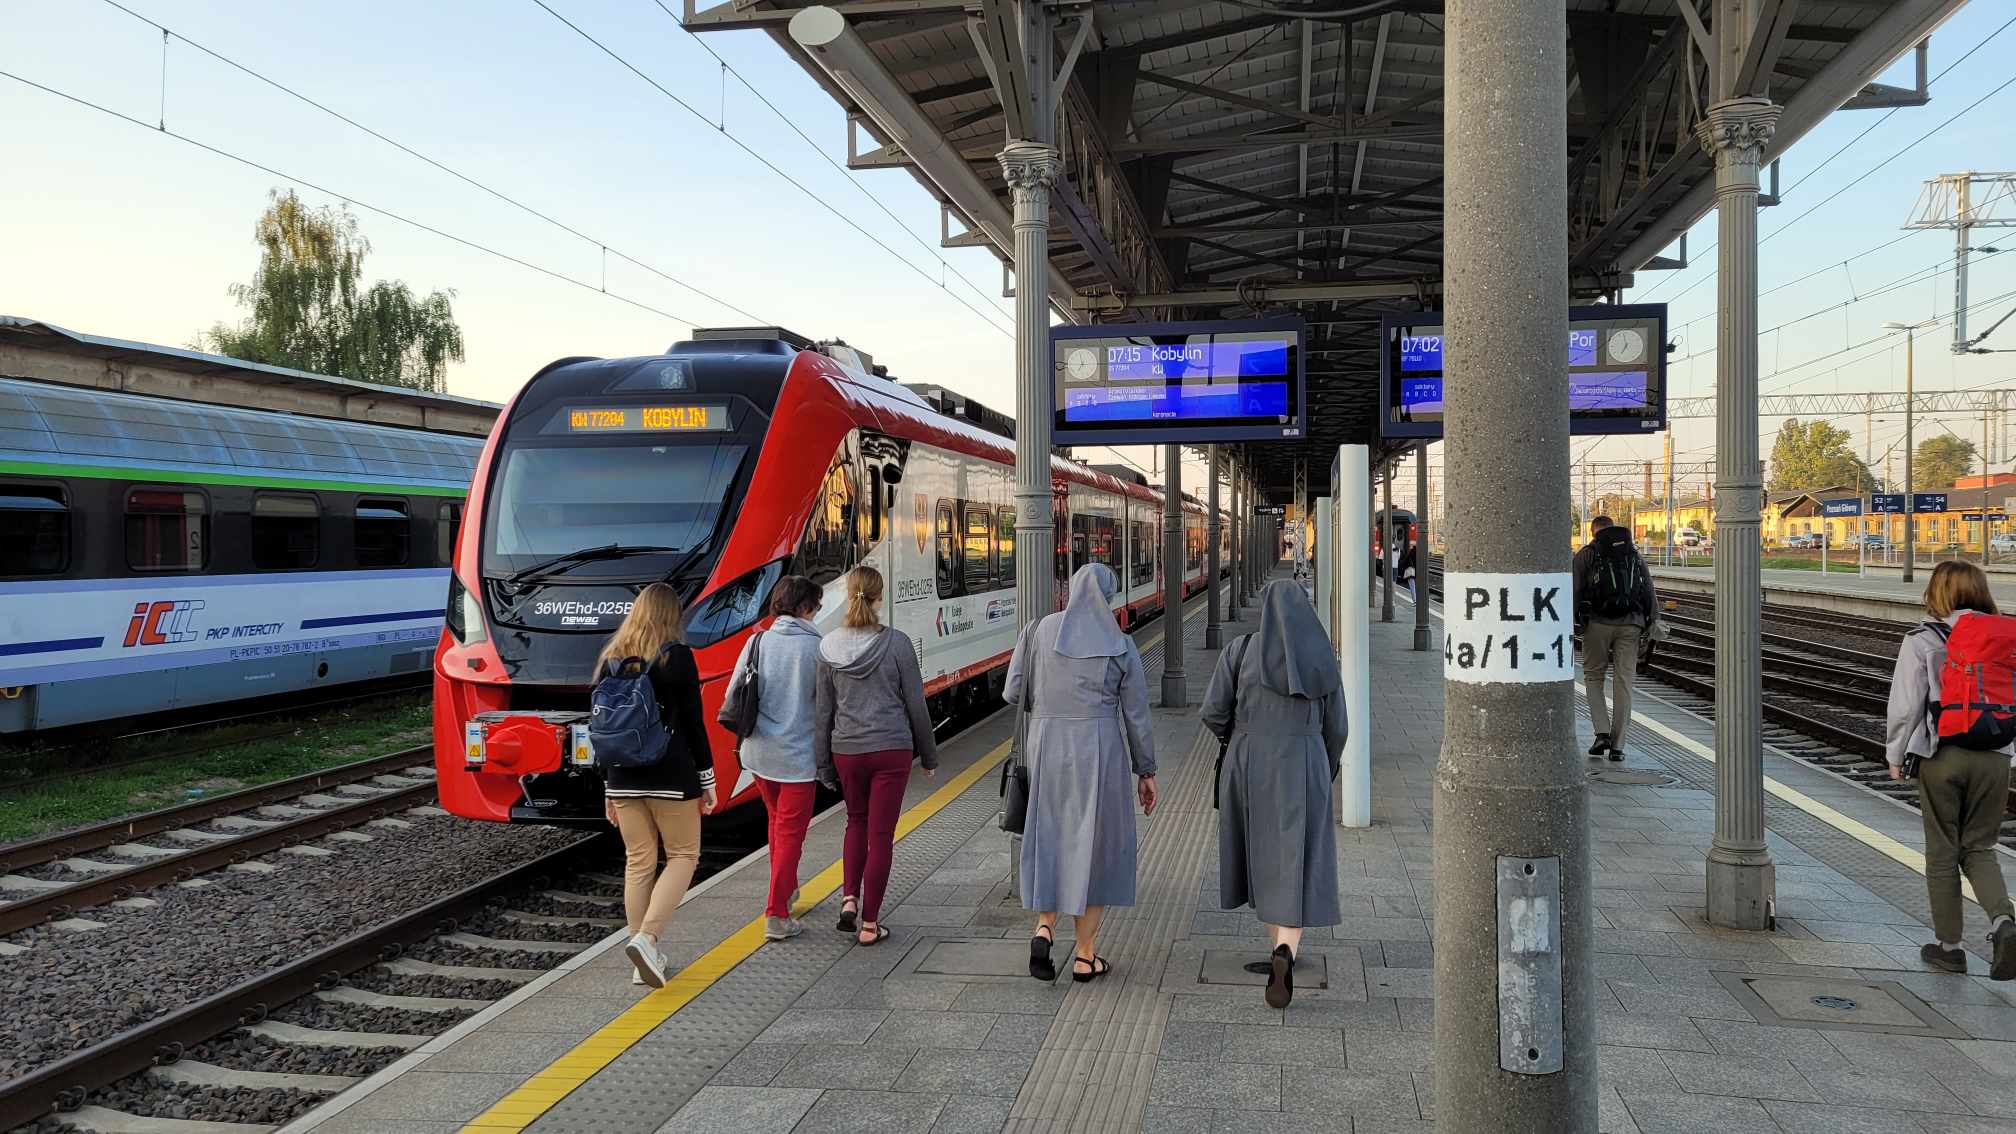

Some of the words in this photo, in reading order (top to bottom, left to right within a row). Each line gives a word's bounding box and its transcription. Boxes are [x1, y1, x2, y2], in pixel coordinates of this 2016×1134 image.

[1401, 336, 1440, 352] 07:02
[1108, 347, 1141, 362] 07:15
[1151, 346, 1202, 363] Kobylin
[642, 406, 707, 428] KOBYLIN
[534, 601, 634, 615] 36WEhd-025B
[1464, 586, 1561, 622] PLK
[560, 616, 600, 625] newag
[205, 626, 228, 641] PKP
[231, 621, 285, 639] INTERCITY
